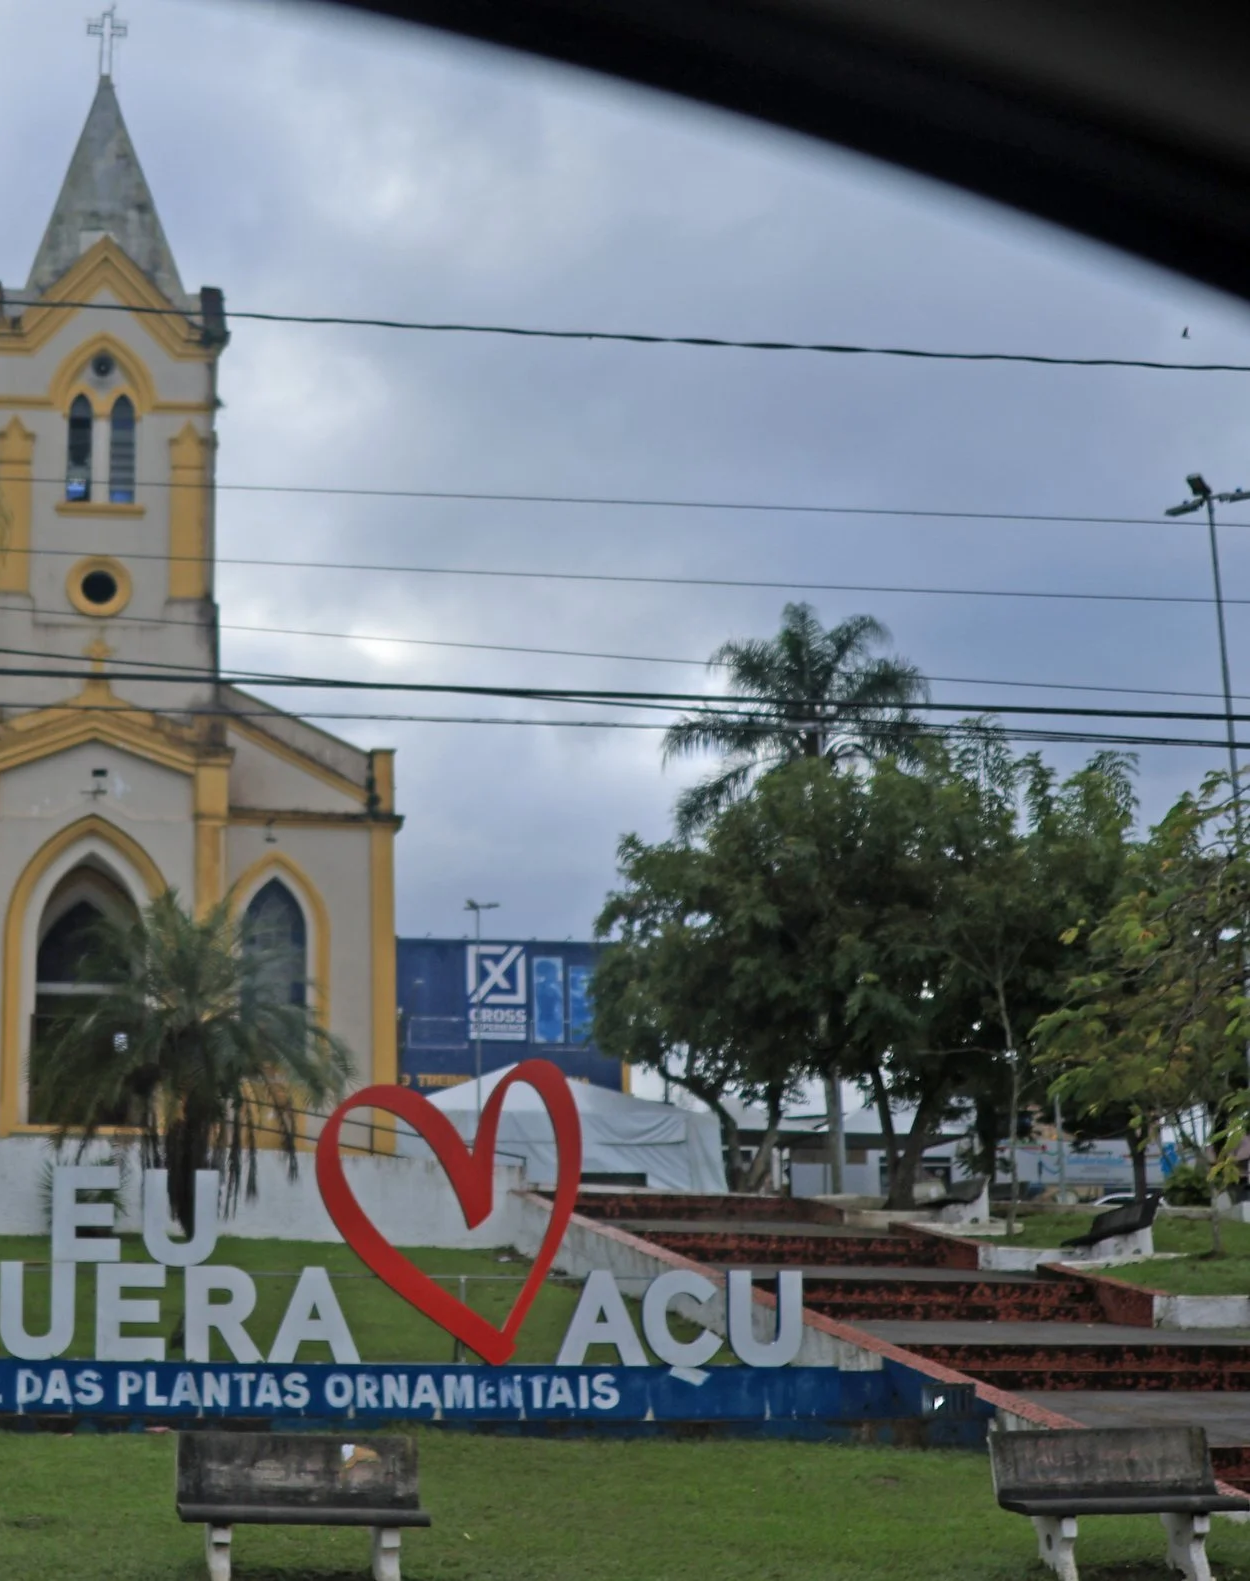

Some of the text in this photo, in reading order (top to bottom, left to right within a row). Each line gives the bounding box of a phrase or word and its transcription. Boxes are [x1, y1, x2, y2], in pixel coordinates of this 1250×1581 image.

[469, 1008, 527, 1023] CROSS
[556, 1269, 803, 1386] AÇU
[16, 1369, 104, 1406] DAS
[118, 1371, 310, 1409] PLANTAS
